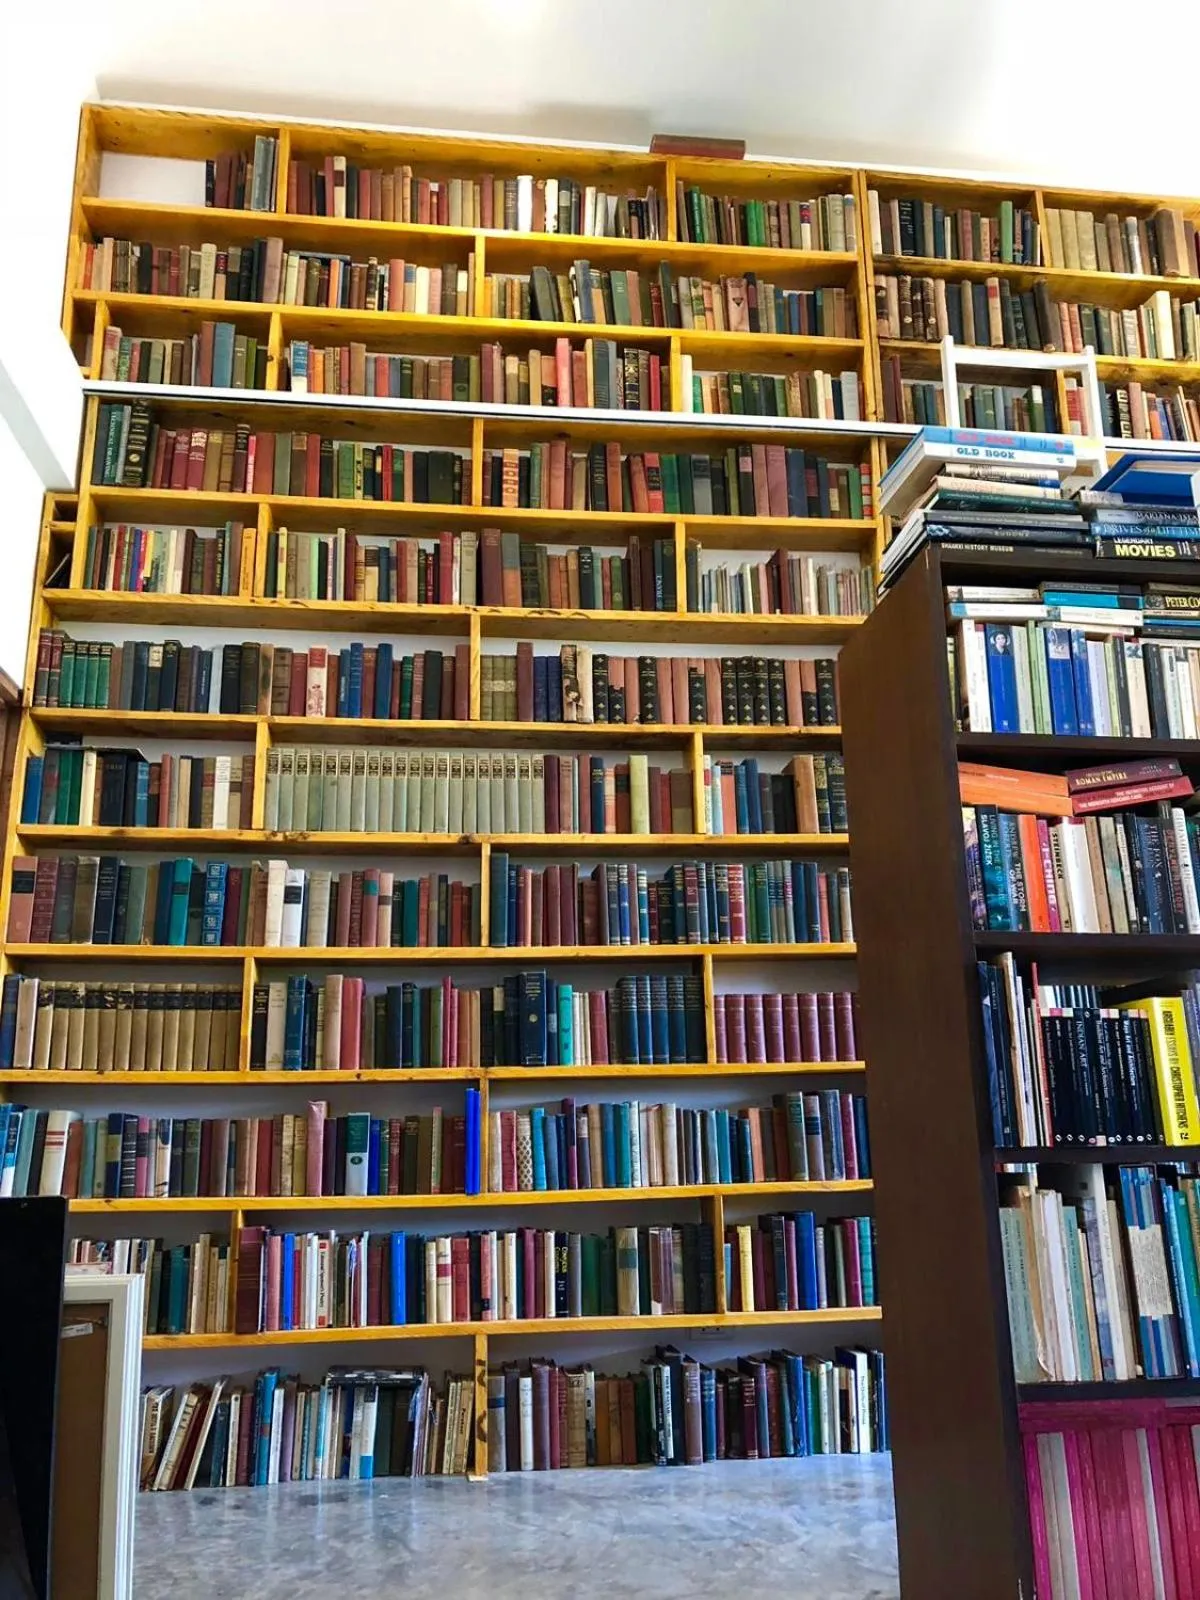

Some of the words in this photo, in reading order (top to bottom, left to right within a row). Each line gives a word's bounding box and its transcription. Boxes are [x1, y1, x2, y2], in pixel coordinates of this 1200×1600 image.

[956, 447, 980, 456] OLD
[985, 449, 1016, 459] BOOK
[1136, 511, 1177, 520] MARIANA
[1103, 523, 1142, 534] DRIVES
[1115, 544, 1176, 557] MOVIES
[1165, 595, 1188, 608] PETER
[1075, 777, 1101, 786] ROMAN
[980, 814, 990, 843] SLAVOJ
[1150, 824, 1160, 845] THE
[988, 814, 998, 838] LIVING
[995, 865, 1004, 882] END
[1051, 832, 1064, 880] STEINBECK
[1152, 848, 1163, 869] FOX
[1009, 868, 1016, 882] OF
[1014, 862, 1023, 879] THE
[1010, 883, 1019, 905] WAR
[1017, 881, 1027, 912] STORM
[1173, 875, 1184, 914] HISTORY
[1075, 1020, 1085, 1049] INDIAN
[1079, 1052, 1088, 1068] ART
[1128, 1055, 1136, 1086] Architecture
[1170, 1066, 1185, 1102] CHRISTOPHER
[1176, 1102, 1189, 1129] HITCHENS
